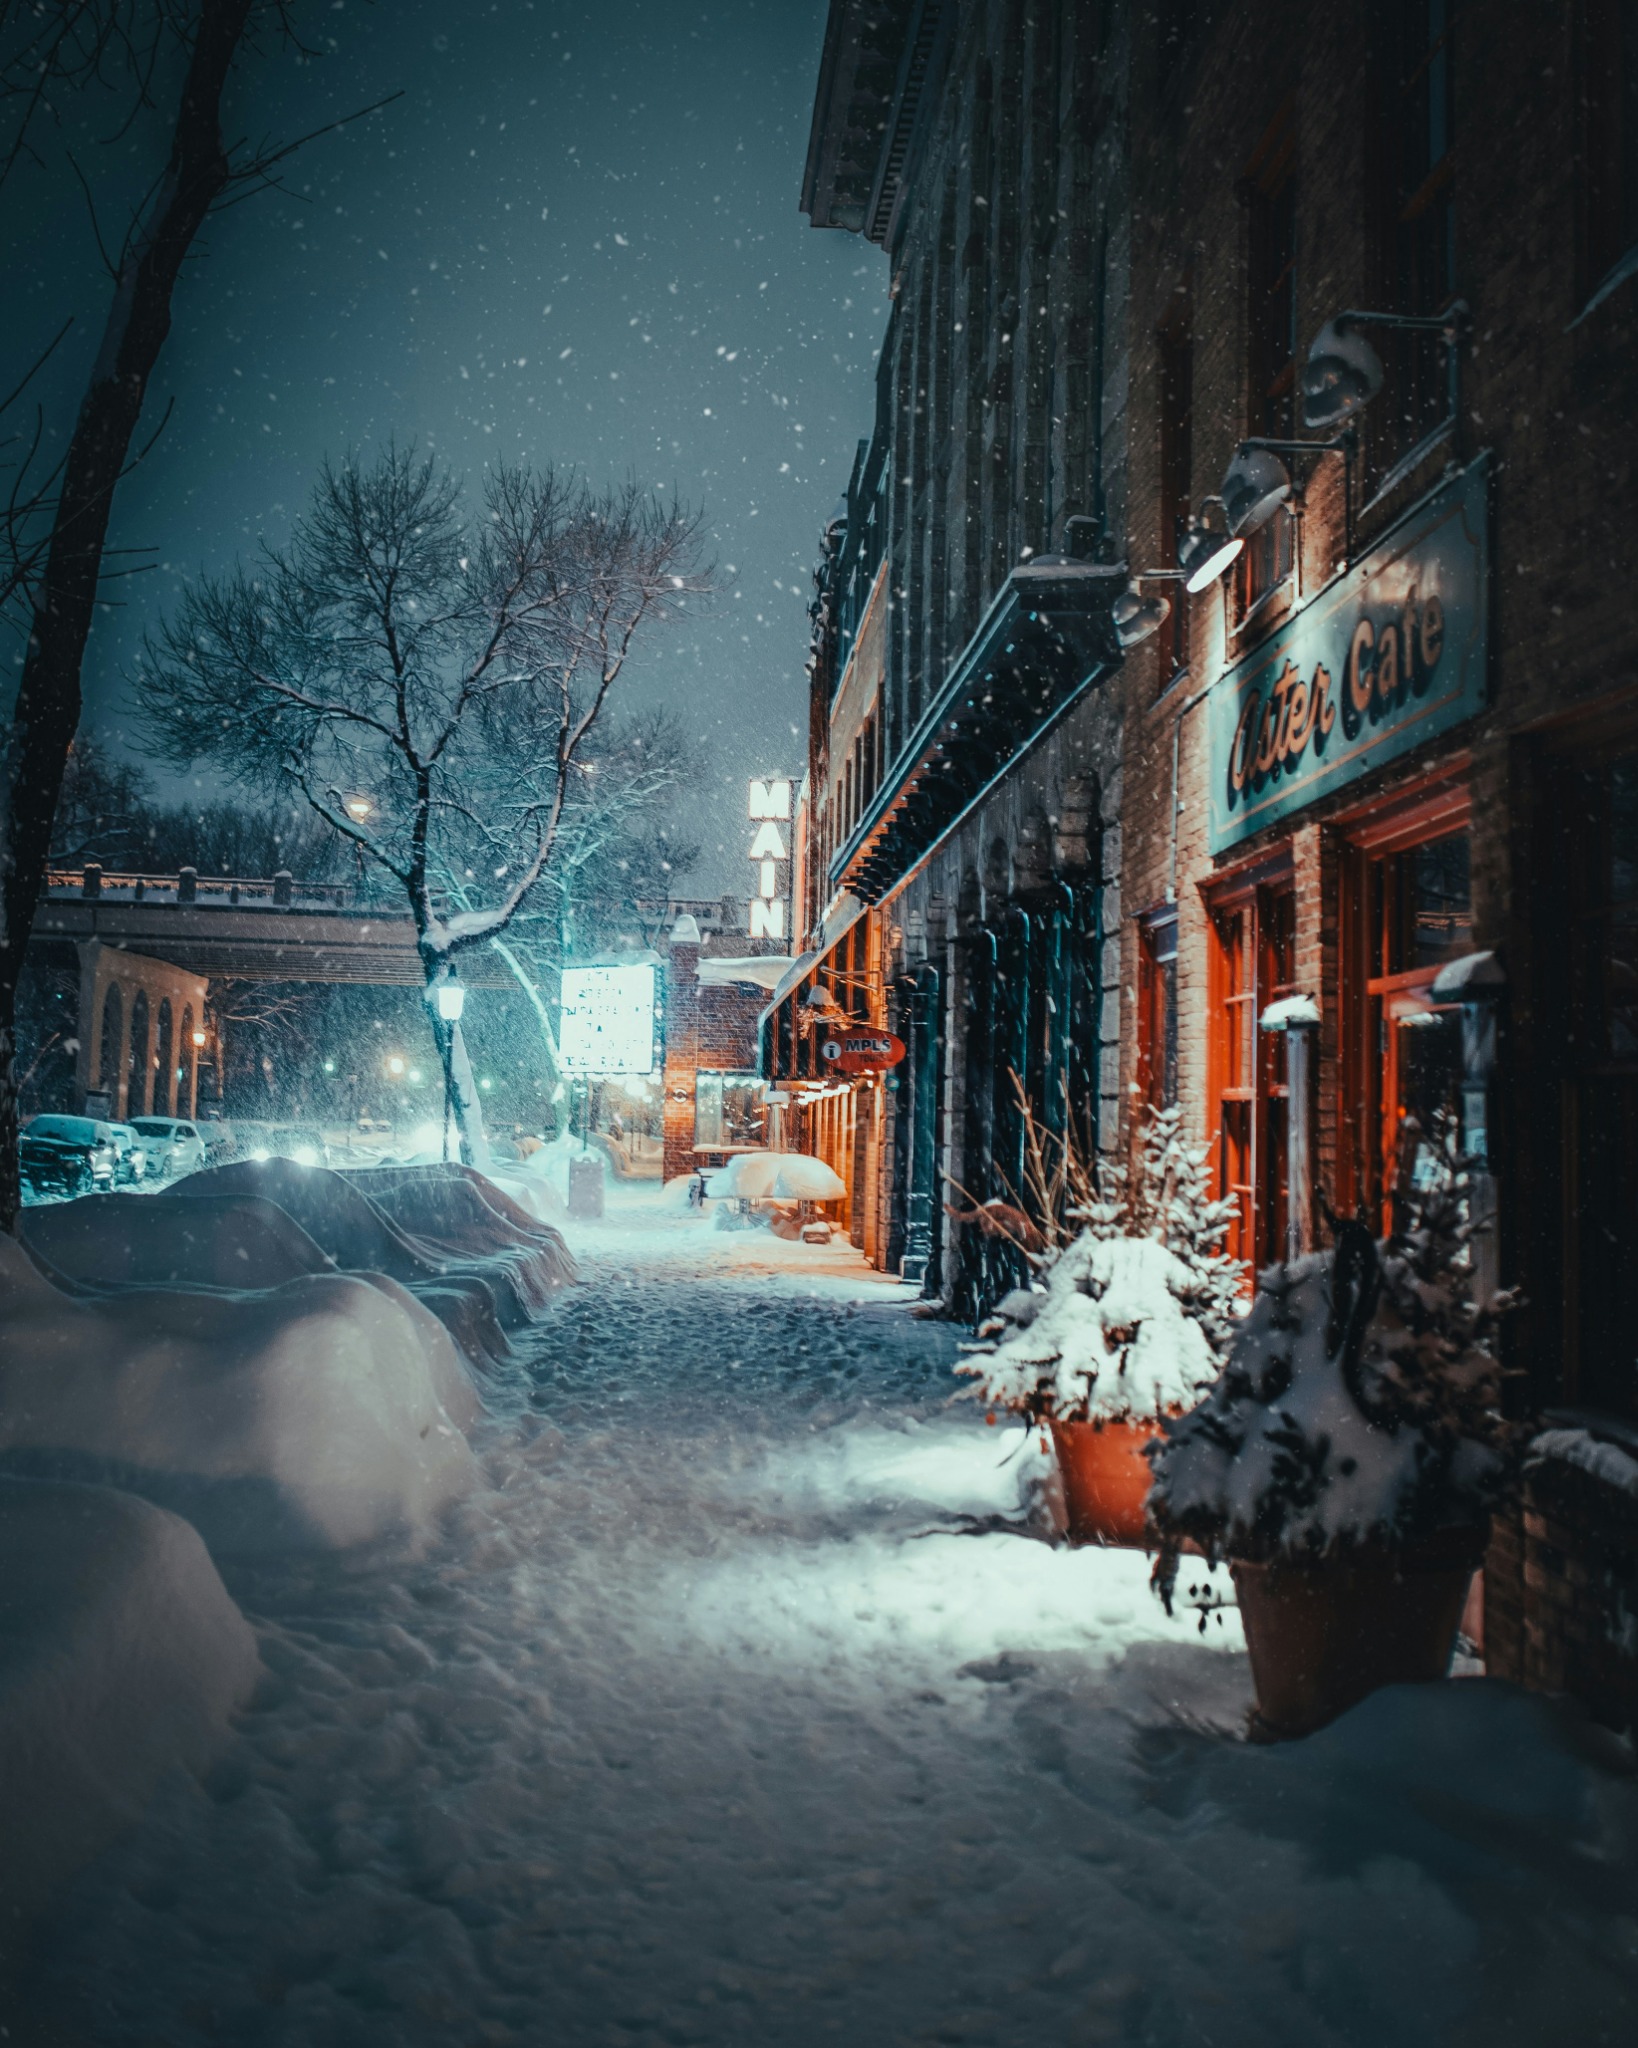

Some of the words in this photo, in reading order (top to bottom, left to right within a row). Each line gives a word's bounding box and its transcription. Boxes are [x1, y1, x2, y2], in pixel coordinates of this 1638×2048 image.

[1229, 659, 1336, 794] Aster
[1349, 583, 1444, 713] Cafe
[749, 781, 790, 938] MAIN
[844, 1038, 892, 1053] MPLS
